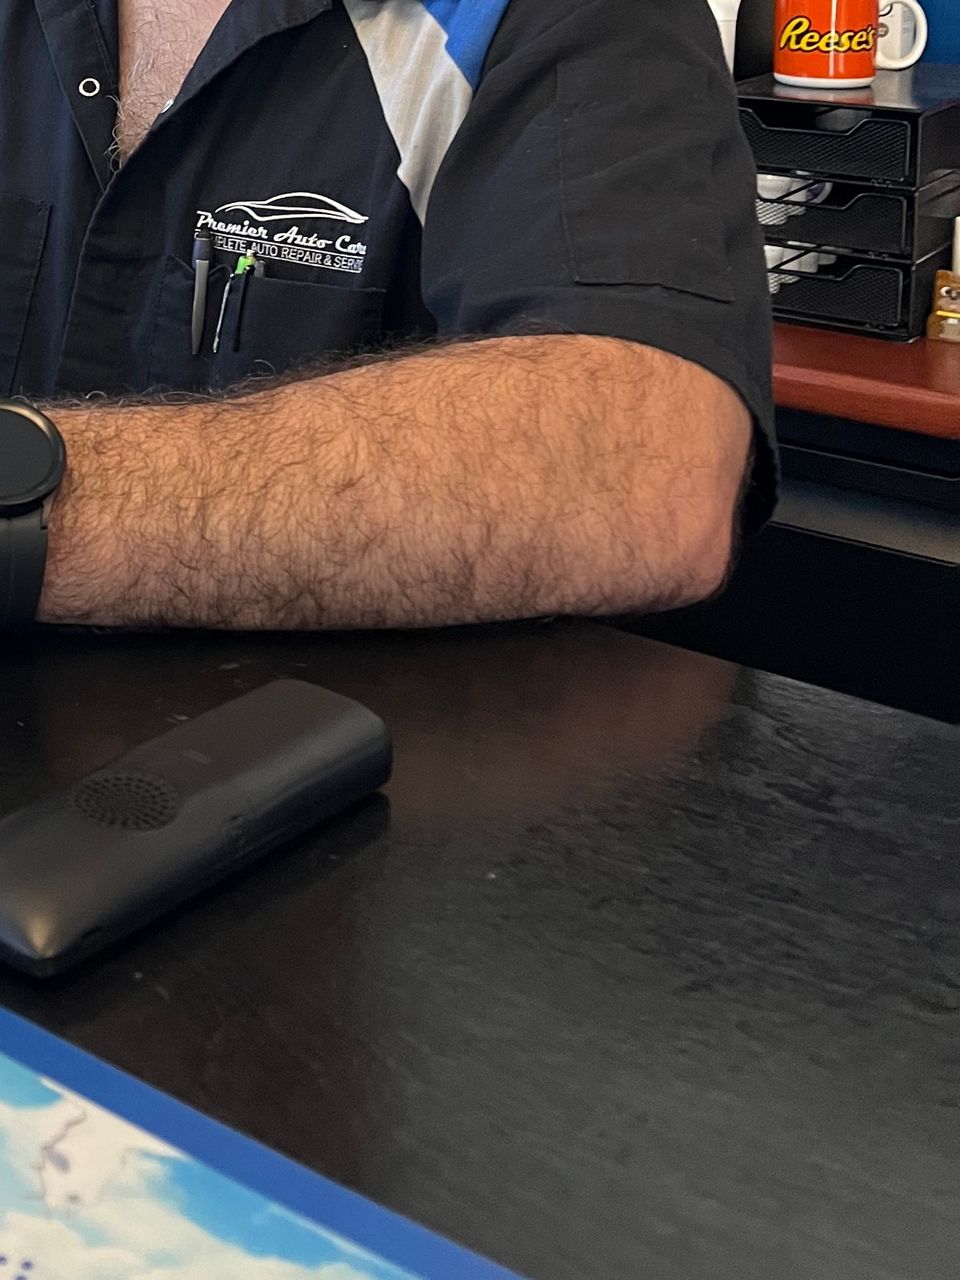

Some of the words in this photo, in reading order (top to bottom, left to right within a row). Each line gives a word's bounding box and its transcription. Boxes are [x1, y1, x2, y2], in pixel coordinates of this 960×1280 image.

[196, 210, 269, 239] Premier
[273, 225, 333, 249] Auto
[251, 242, 279, 257] AUTO
[281, 247, 323, 265] REPAIR
[323, 254, 333, 266] &
